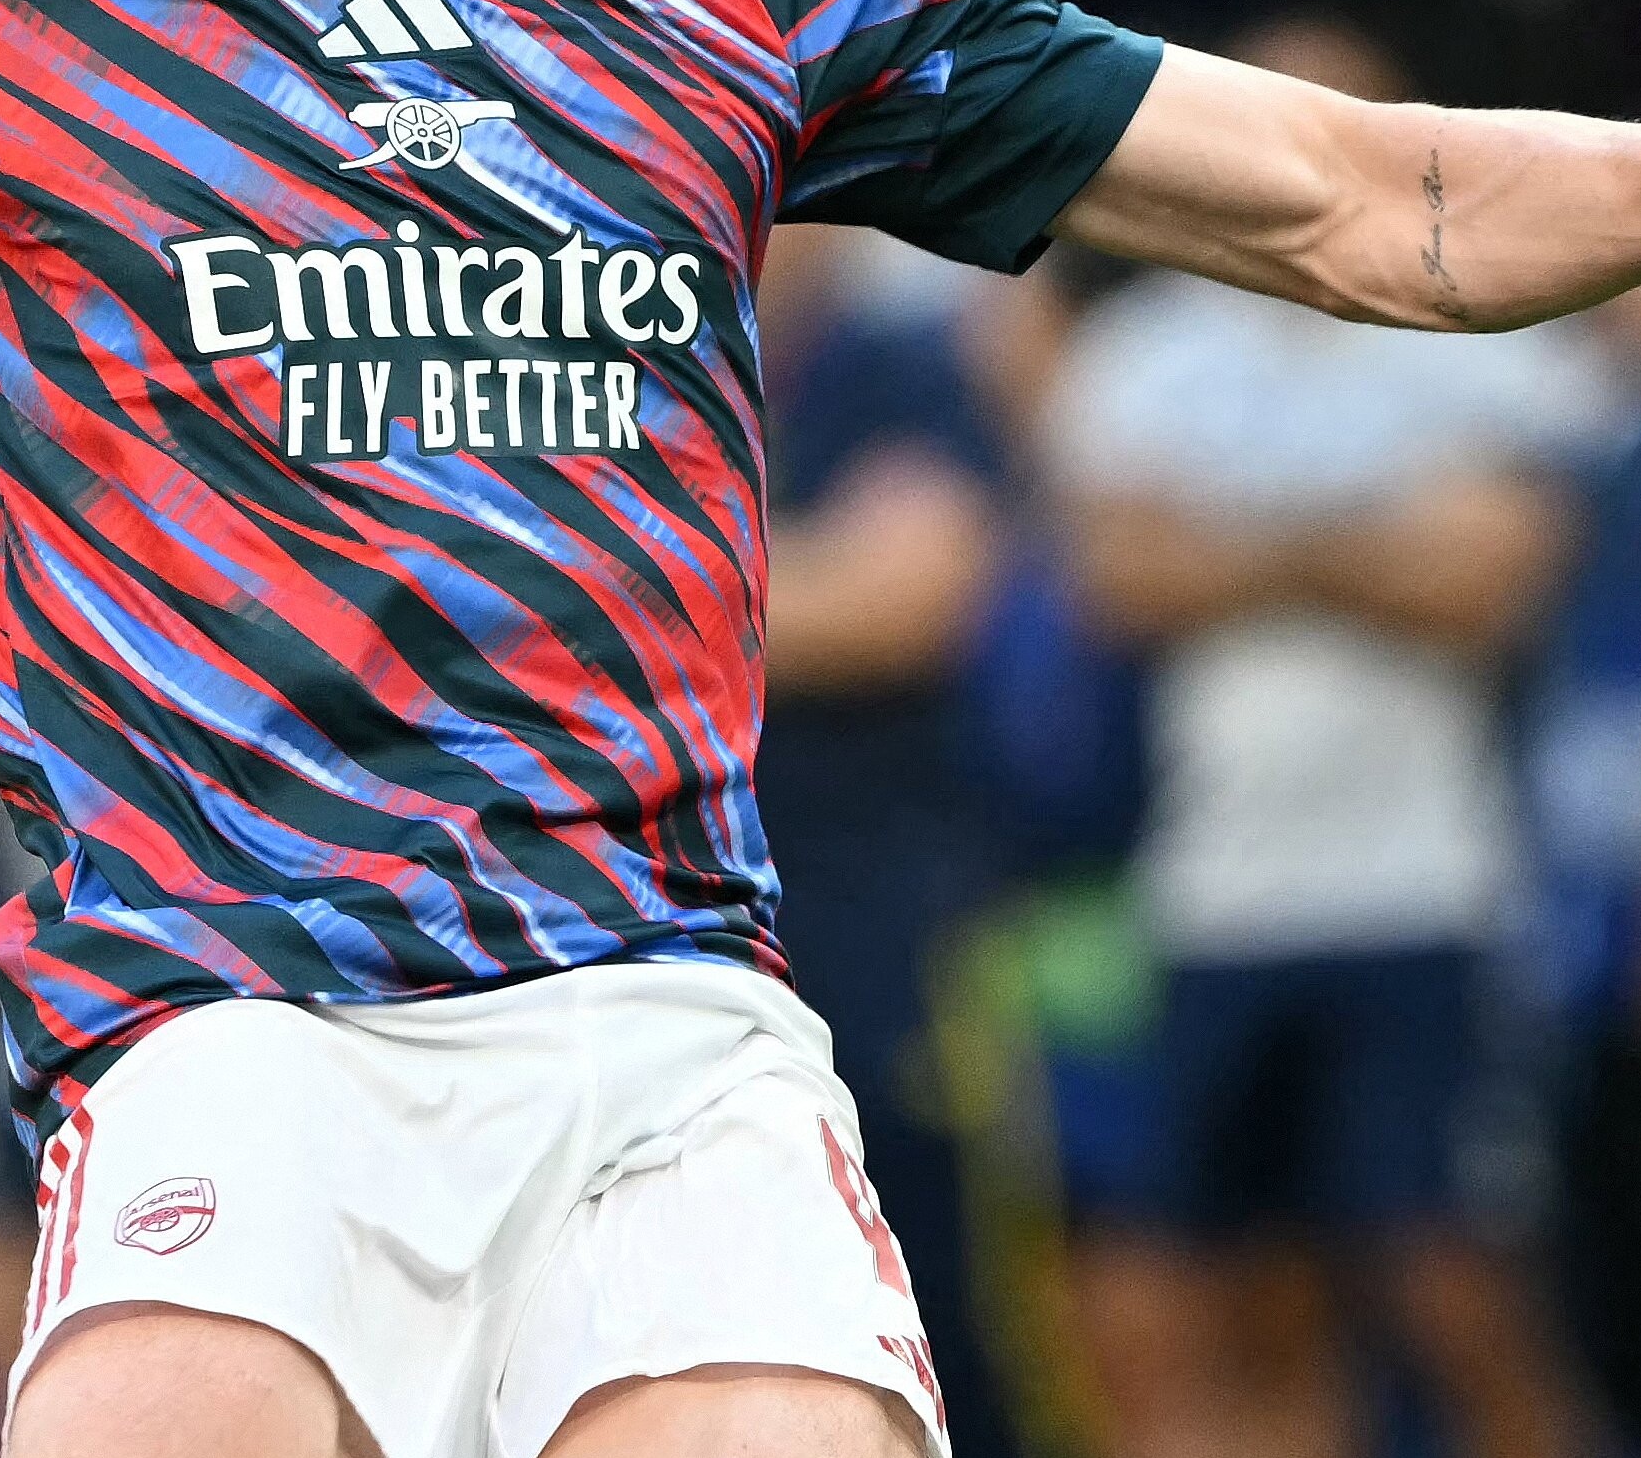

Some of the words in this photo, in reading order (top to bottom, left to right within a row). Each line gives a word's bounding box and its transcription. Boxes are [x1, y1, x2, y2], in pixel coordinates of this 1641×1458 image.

[168, 219, 701, 355] Emirates
[286, 360, 391, 458] FLY
[420, 358, 642, 452] BETTER
